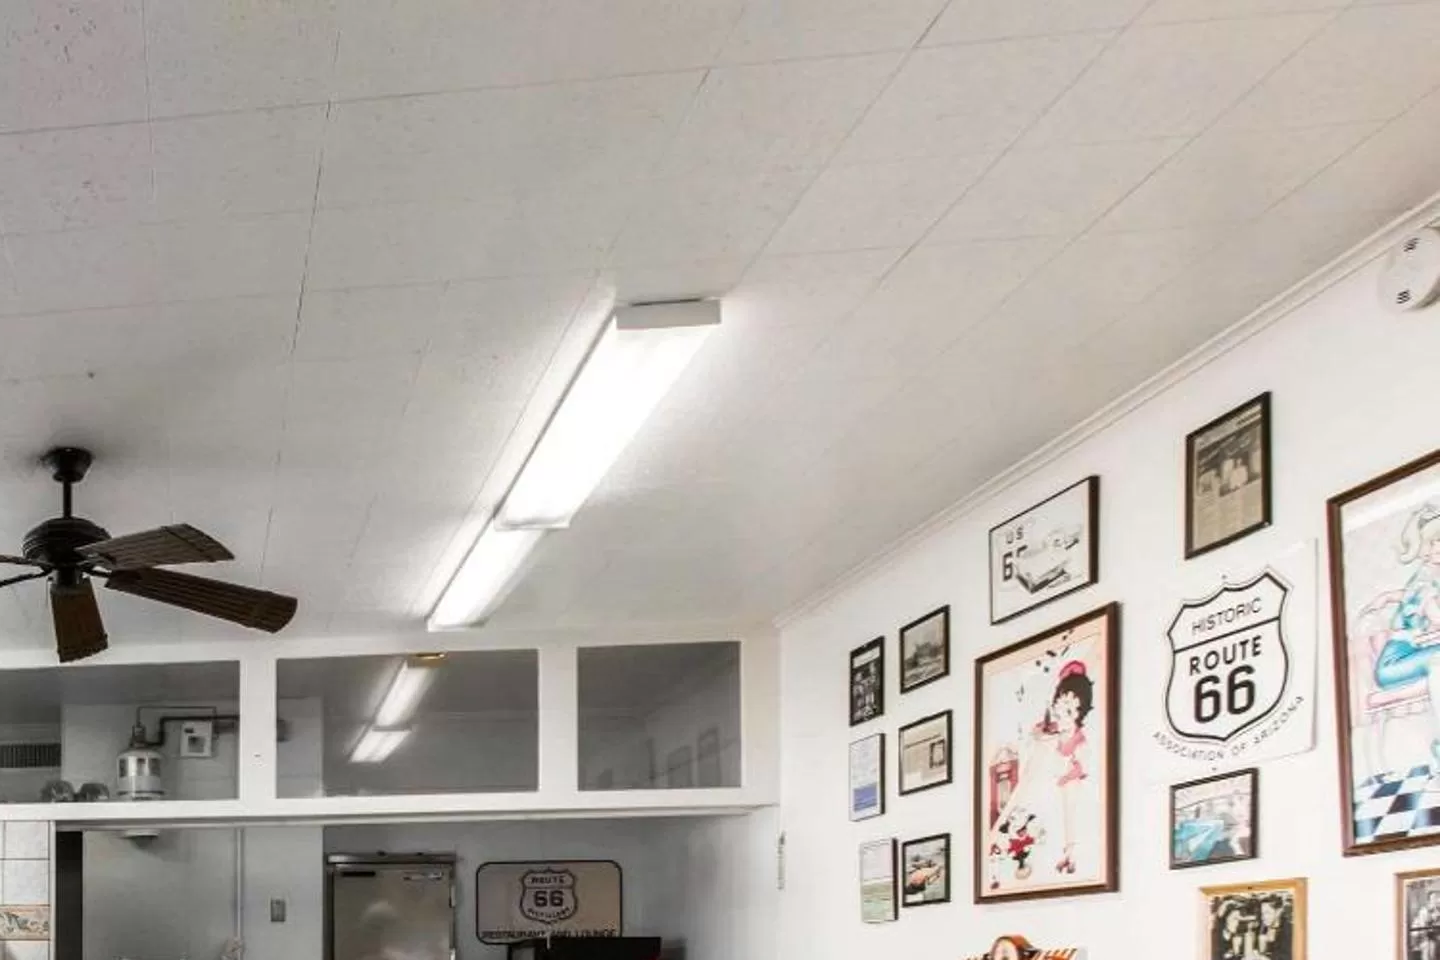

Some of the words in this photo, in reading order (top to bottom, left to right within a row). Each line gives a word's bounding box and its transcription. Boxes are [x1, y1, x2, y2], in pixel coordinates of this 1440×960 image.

[1191, 598, 1262, 634] HISTORIC
[1189, 635, 1263, 676] ROUTE
[1194, 664, 1256, 724] 66
[1152, 731, 1225, 761] ASSOCIATION
[1230, 743, 1247, 756] OF
[1254, 696, 1305, 744] ARIZONA
[531, 876, 565, 884] ROUTE
[534, 890, 563, 907] 66
